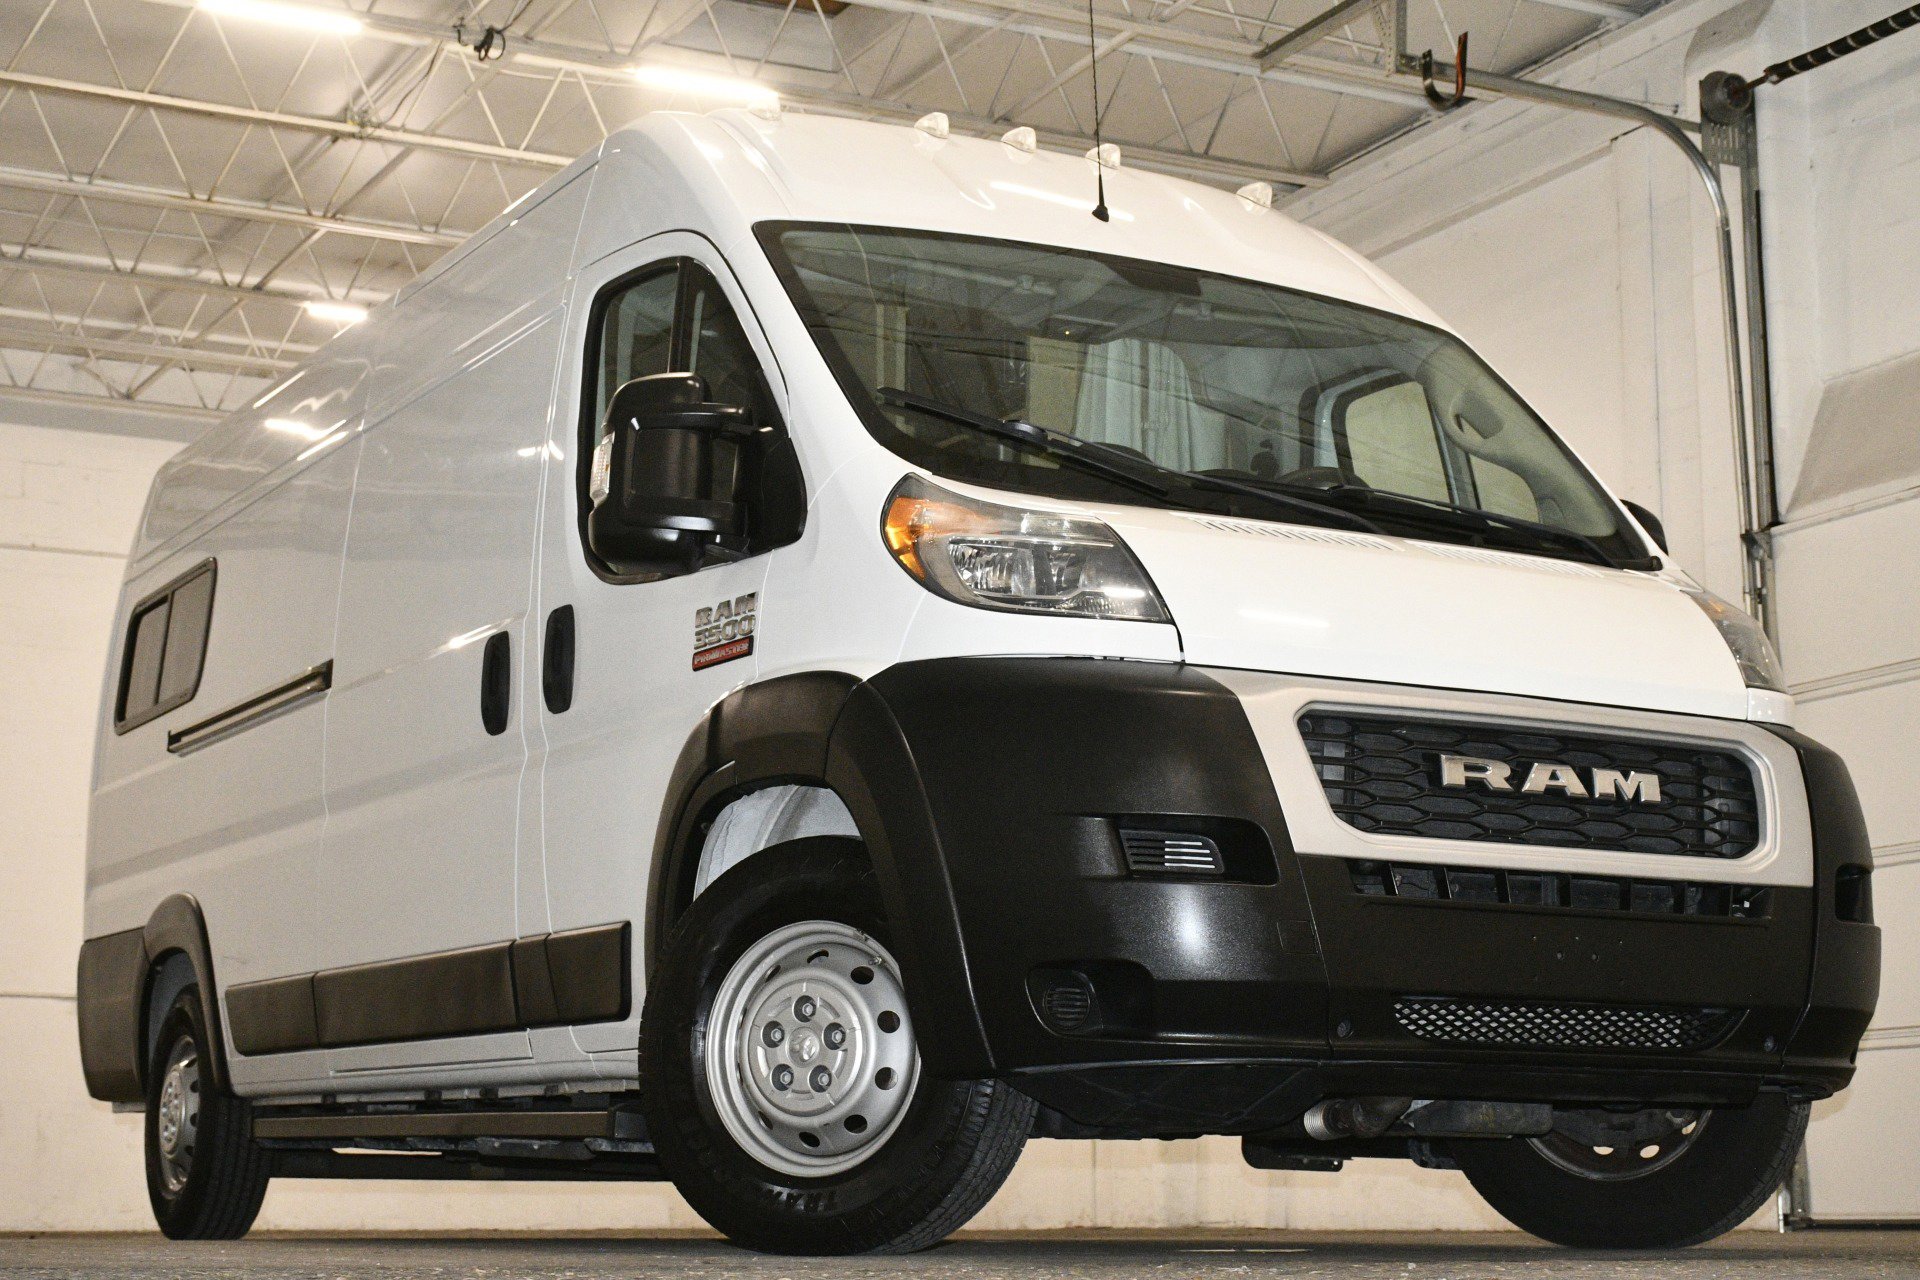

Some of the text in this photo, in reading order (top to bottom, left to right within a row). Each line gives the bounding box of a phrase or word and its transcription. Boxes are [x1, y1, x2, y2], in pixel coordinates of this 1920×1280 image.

[695, 592, 759, 628] RAM
[694, 614, 756, 650] 3500
[1440, 753, 1662, 802] RAM
